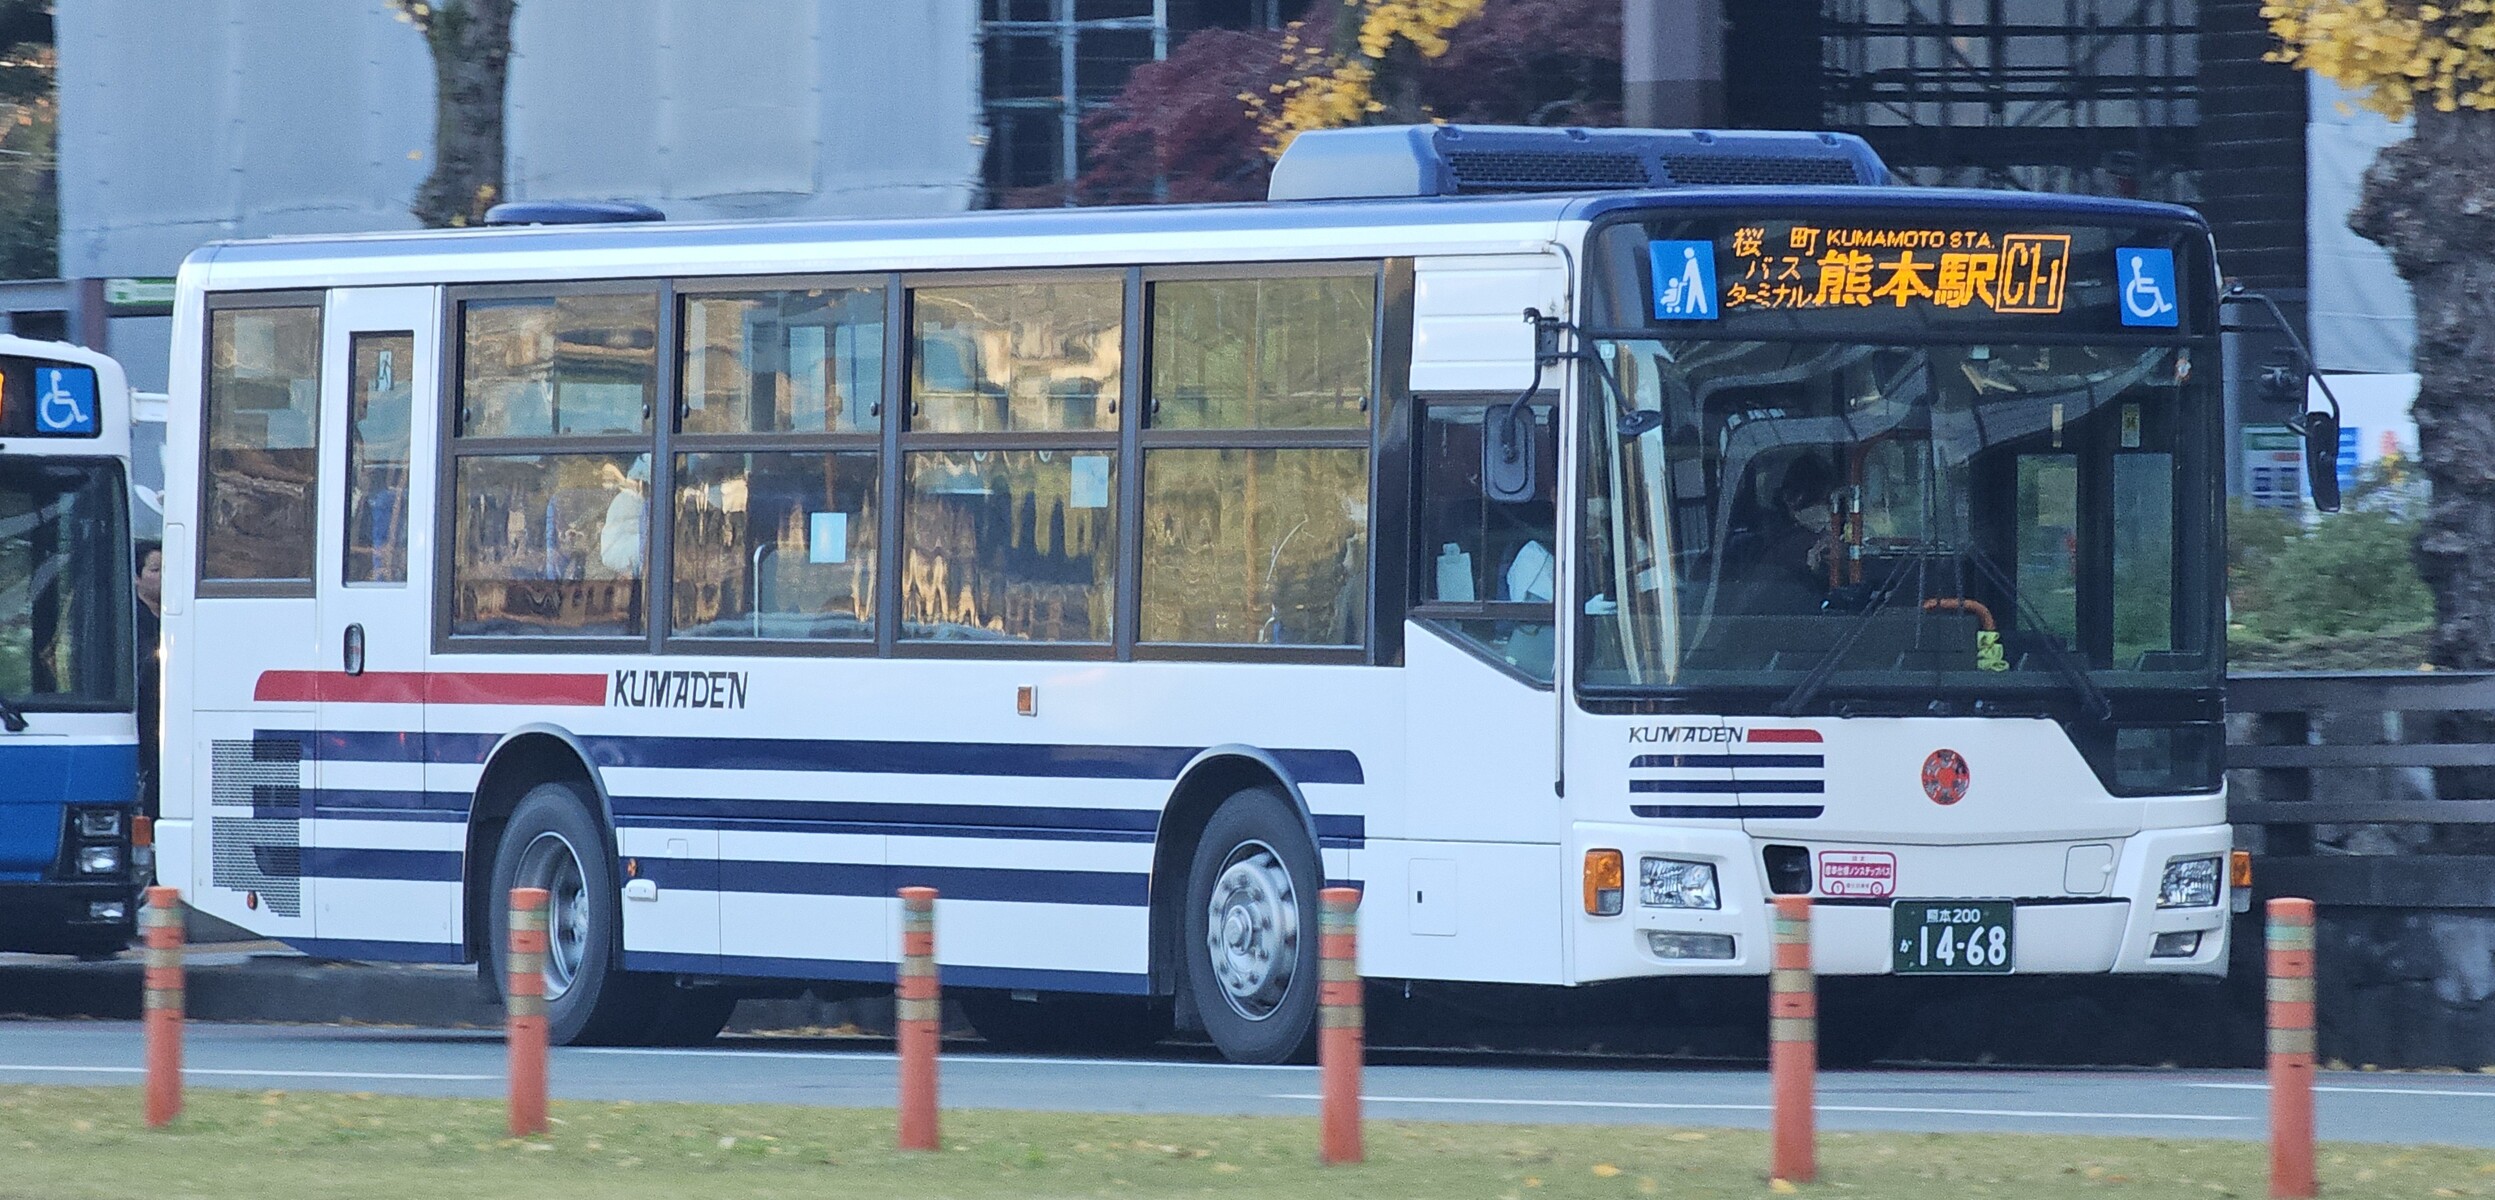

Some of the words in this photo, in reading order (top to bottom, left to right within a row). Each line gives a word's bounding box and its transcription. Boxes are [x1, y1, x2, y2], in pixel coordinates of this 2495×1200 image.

[1826, 229, 1946, 248] KUMAMOTO
[1950, 231, 1996, 249] STA.
[1745, 256, 1802, 281] バス
[1812, 249, 1999, 308] 熊本駅
[1725, 282, 1813, 308] ターミナル
[613, 669, 749, 709] KUMADEN
[1629, 726, 1744, 743] KUMADEN
[1919, 925, 2007, 967] 14-68
